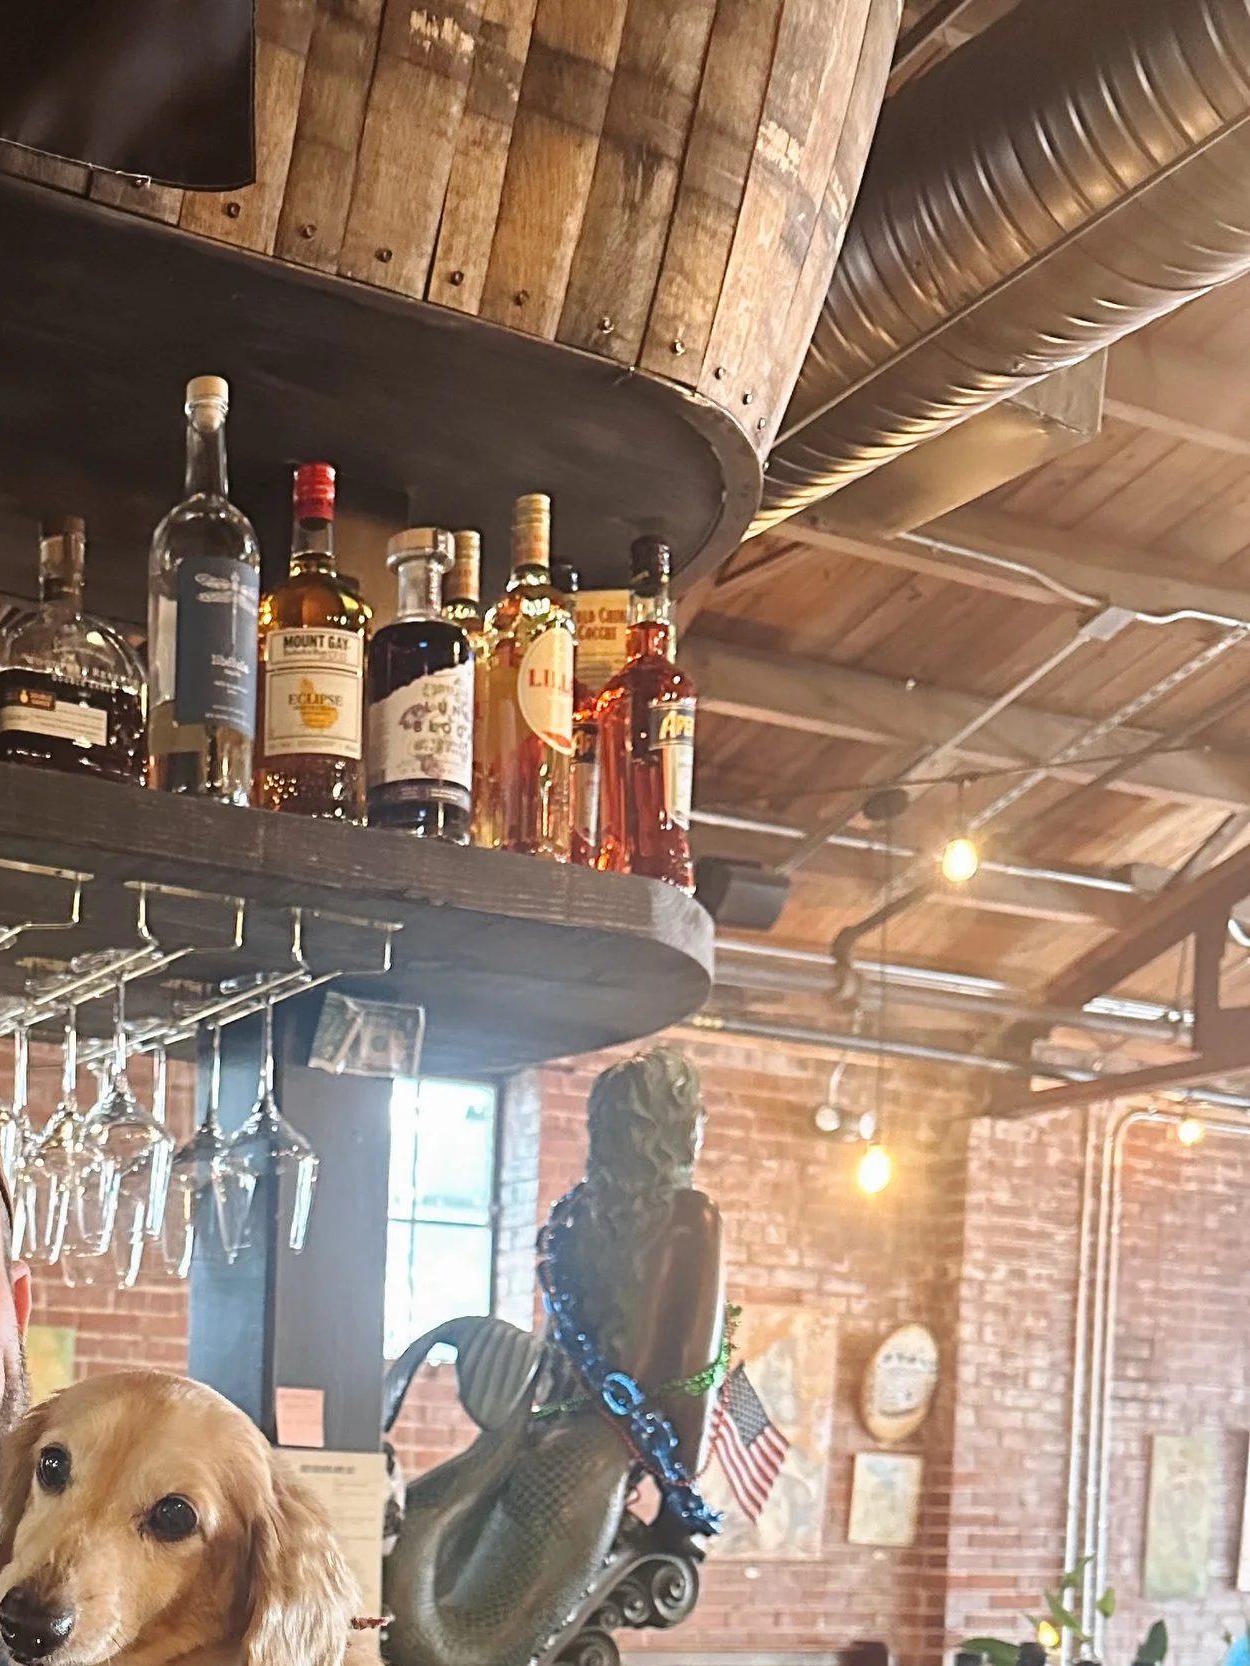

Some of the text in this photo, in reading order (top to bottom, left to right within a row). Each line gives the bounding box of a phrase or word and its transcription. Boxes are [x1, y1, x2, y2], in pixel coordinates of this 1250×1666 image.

[283, 634, 349, 651] MOUNT GAY
[528, 668, 574, 695] LILL
[287, 693, 344, 707] ECLIPSE
[659, 710, 693, 740] APE
